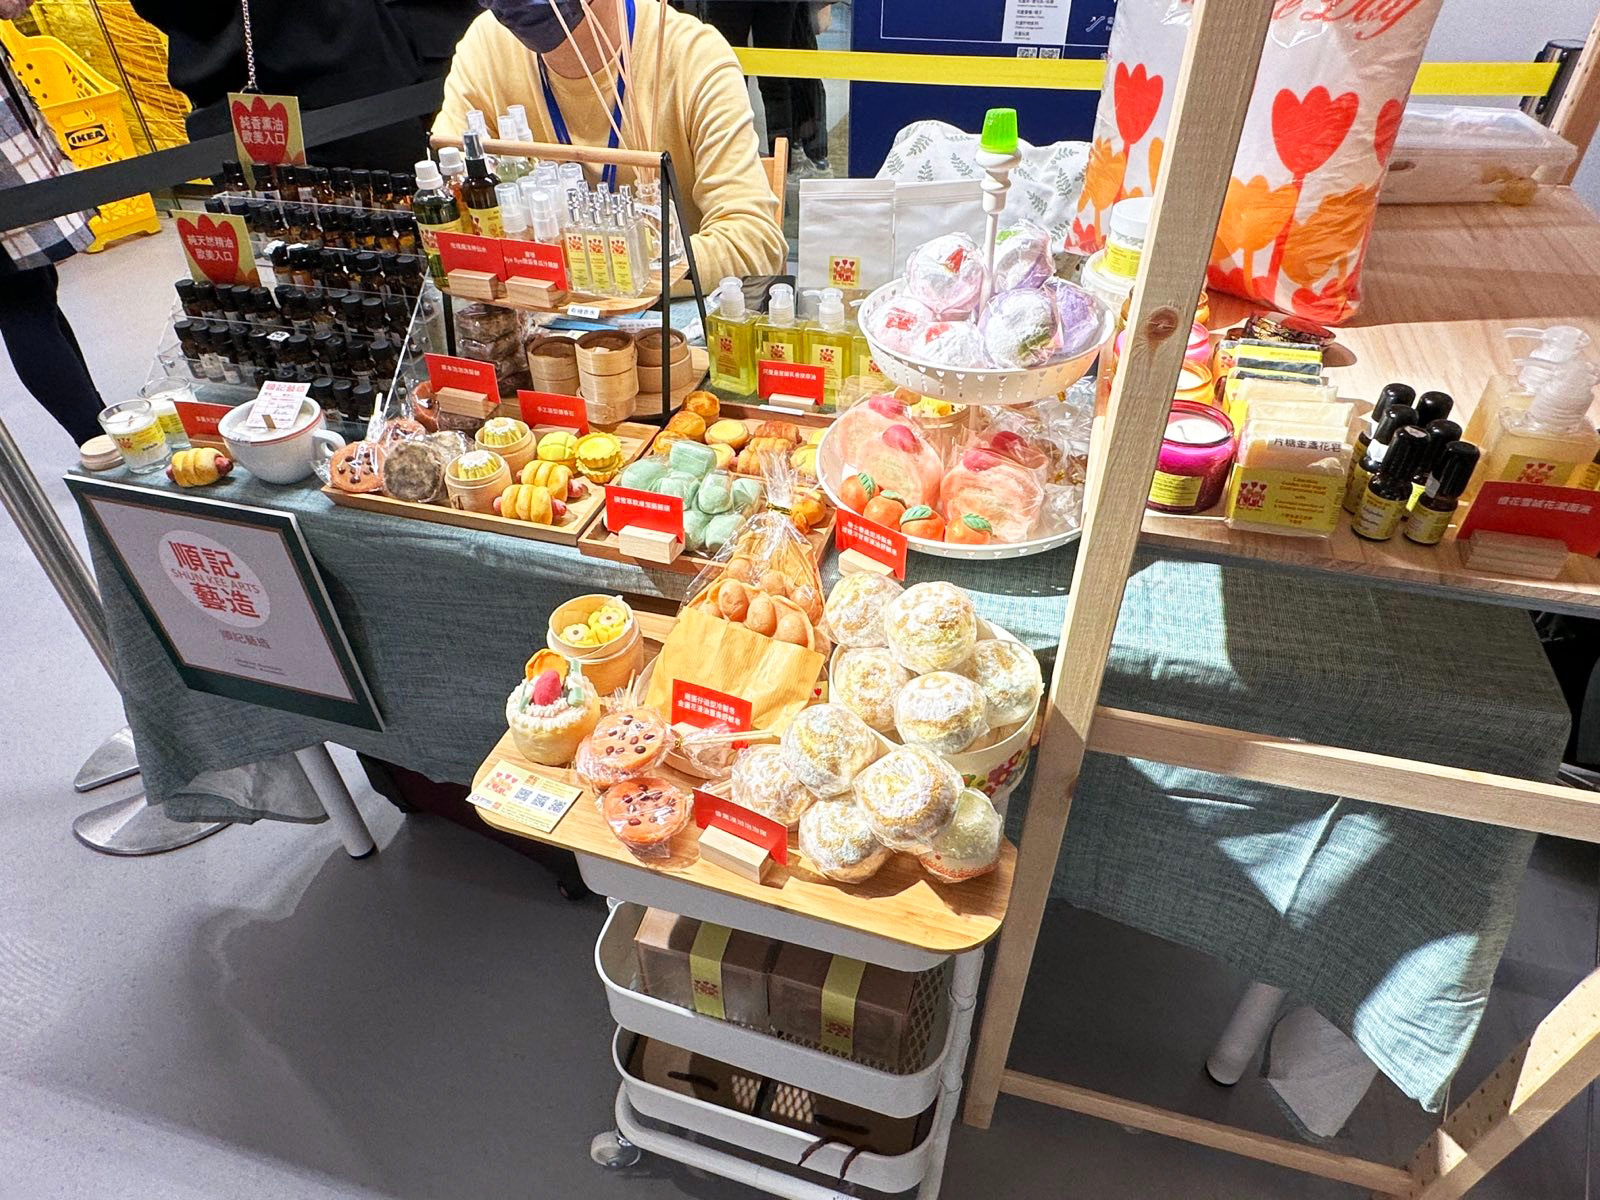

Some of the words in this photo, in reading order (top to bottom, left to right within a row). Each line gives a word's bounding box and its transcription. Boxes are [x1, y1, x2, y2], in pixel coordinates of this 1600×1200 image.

[70, 129, 105, 144] IKEA
[241, 130, 286, 146] 歐美入口
[1273, 438, 1342, 453] 片糖金盞花皂
[168, 540, 240, 579] 順記
[171, 568, 205, 583] SHUN
[207, 577, 227, 589] KEE
[231, 581, 260, 595] ARTS
[190, 583, 261, 618] 藝造
